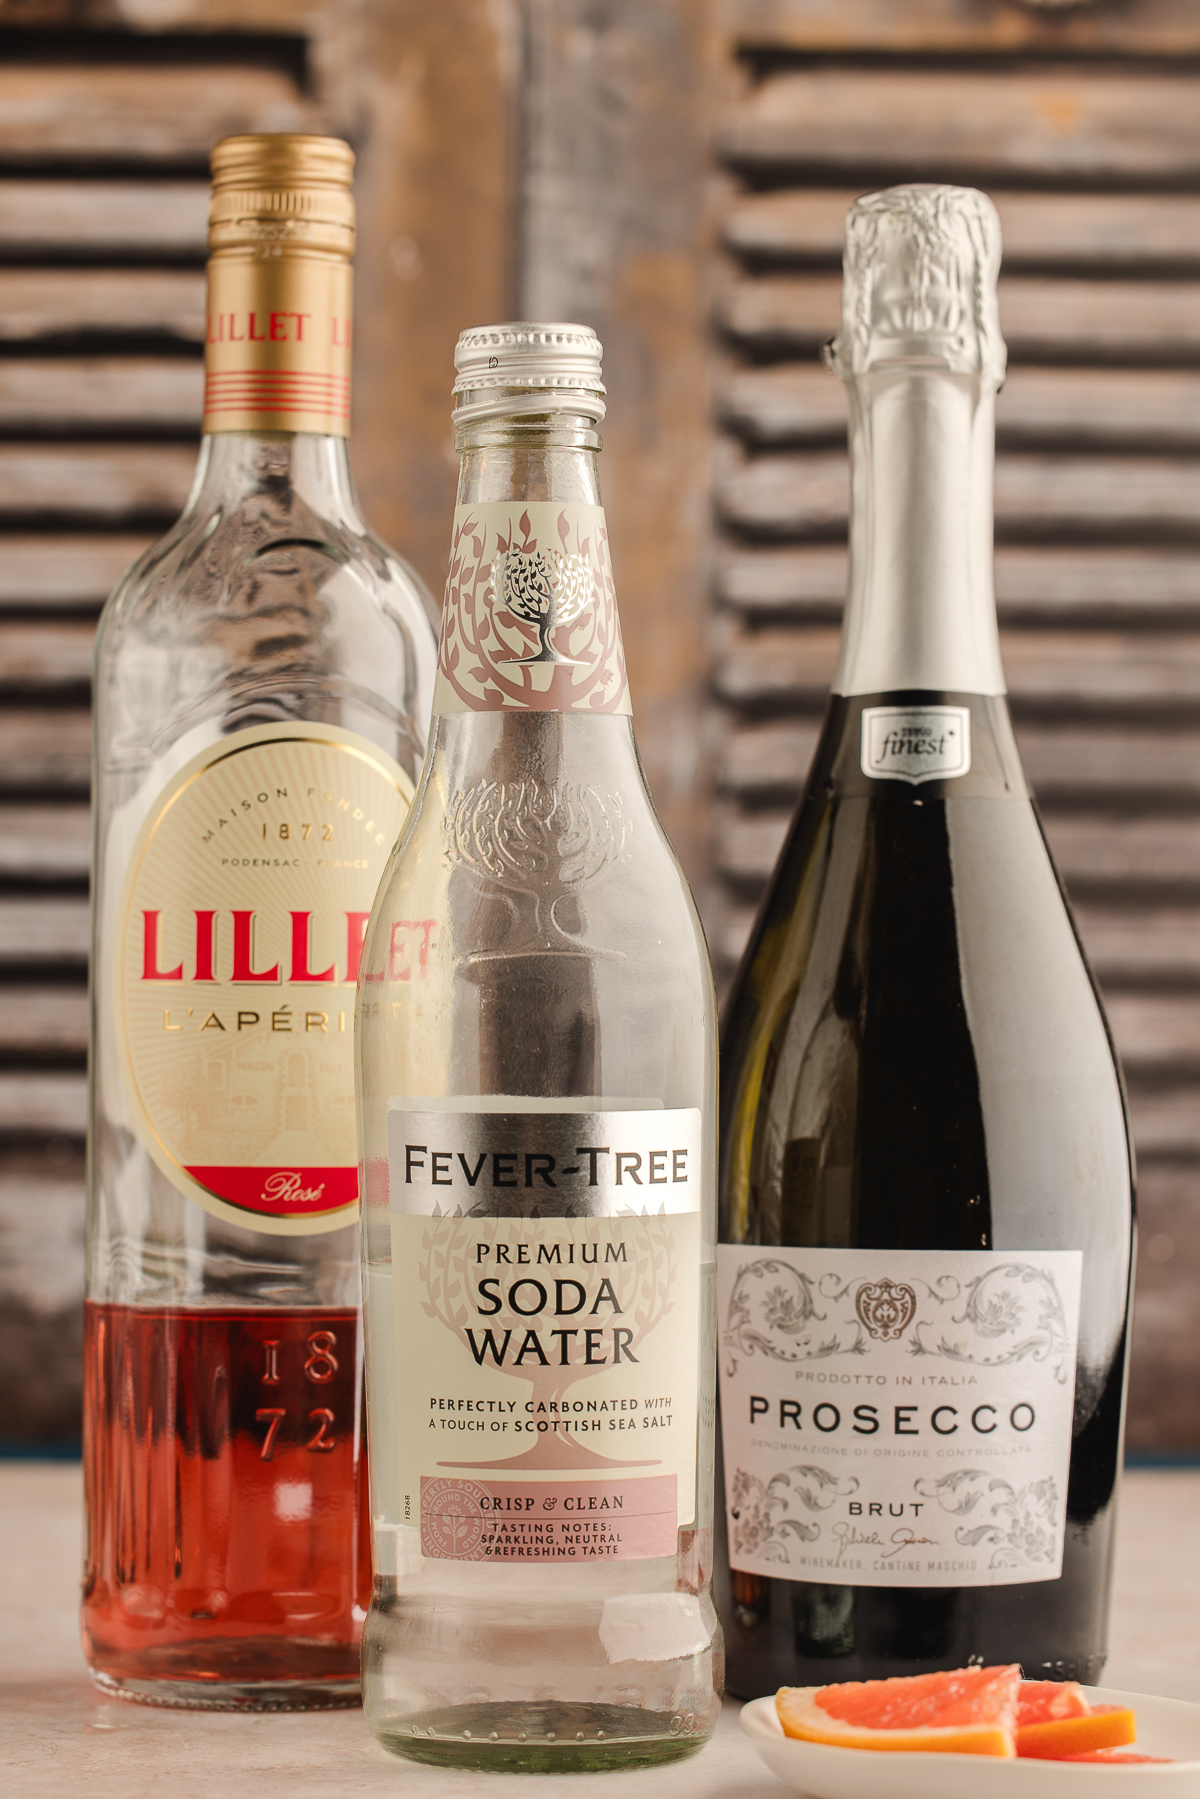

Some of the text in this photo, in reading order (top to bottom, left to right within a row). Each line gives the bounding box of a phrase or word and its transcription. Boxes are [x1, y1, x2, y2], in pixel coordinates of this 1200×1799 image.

[207, 311, 311, 344] LILLET
[203, 788, 288, 844] MAISON
[261, 823, 334, 840] 1872
[220, 857, 371, 870] PODENSAC FRANCE
[260, 1171, 326, 1202] Rosé
[475, 1242, 629, 1265] PREMIUM
[476, 1277, 624, 1317] SODA
[464, 1327, 641, 1368] WATER
[794, 1371, 979, 1387] PRODOTTO IN ITALIA
[430, 1396, 673, 1414] PERFECTLY CARBONATED WITH
[428, 1414, 674, 1434] A TOUCH OF SCOTTISH SEA SALT
[749, 1395, 1037, 1436] PROSECCO
[750, 1438, 849, 1457] DENOMINAZIONE
[873, 1448, 931, 1459] ORIGINE
[935, 1444, 1034, 1459] CONTROLLATA
[480, 1495, 624, 1511] CRISP & CLEAN
[849, 1502, 924, 1517] BRUT
[430, 1493, 481, 1549] FROM AROUND THE WORLD
[491, 1523, 612, 1533] TASTING NOTES:
[481, 1533, 622, 1545] SPARKLING, NEUTRAL
[581, 1545, 619, 1555] TASTE
[872, 1560, 921, 1571] CANTINE
[927, 1560, 977, 1571] MASCHIO
